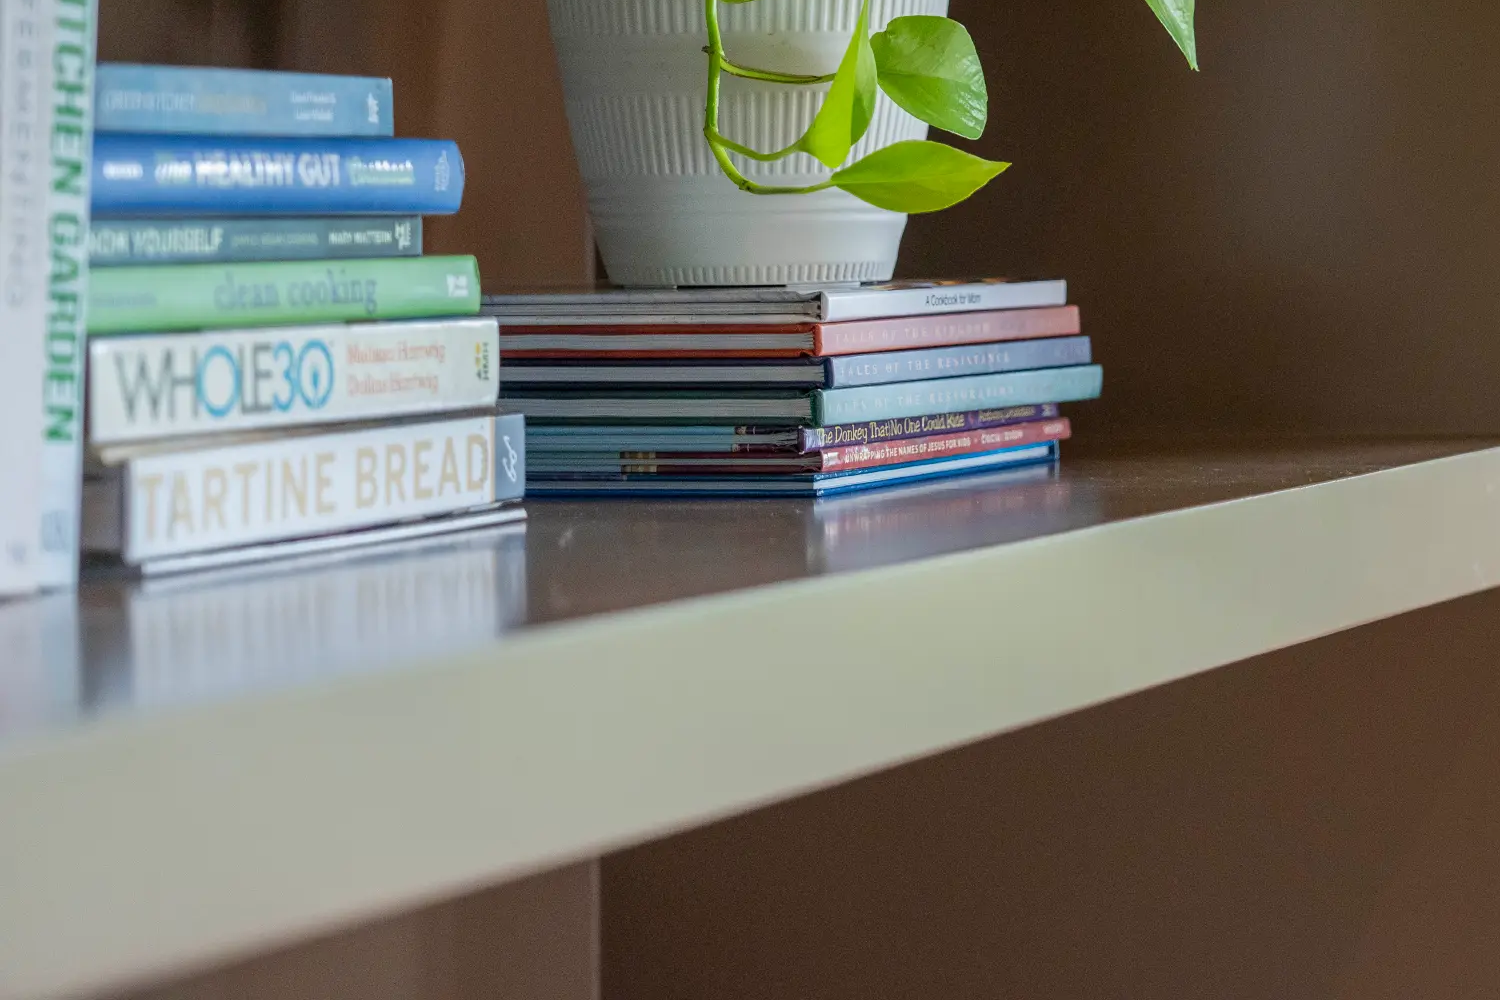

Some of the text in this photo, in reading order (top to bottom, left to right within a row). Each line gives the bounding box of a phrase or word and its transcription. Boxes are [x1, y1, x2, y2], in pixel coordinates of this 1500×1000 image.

[196, 149, 294, 187] HEALTHY
[298, 153, 340, 187] GUT
[131, 227, 224, 257] YOURSELF
[214, 268, 378, 315] clean cooking
[925, 296, 931, 306] A
[931, 294, 958, 307] Cookbook
[45, 212, 80, 442] GARDEN
[904, 326, 928, 339] THE
[114, 338, 334, 424] WHOLE30
[840, 363, 878, 377] TALES
[907, 359, 930, 372] THE
[897, 393, 921, 407] THE
[817, 427, 833, 447] The
[834, 424, 869, 445] Donkey
[870, 421, 888, 438] That
[890, 420, 903, 436] No
[904, 417, 921, 434] One
[922, 415, 947, 432] Could
[947, 413, 965, 429] Ride
[886, 446, 898, 459] THE
[898, 443, 919, 457] NAMES
[919, 441, 928, 453] OF
[927, 439, 945, 452] JESUS
[945, 438, 957, 449] FOR
[137, 453, 337, 544] TARTINE
[355, 433, 490, 510] BREAD
